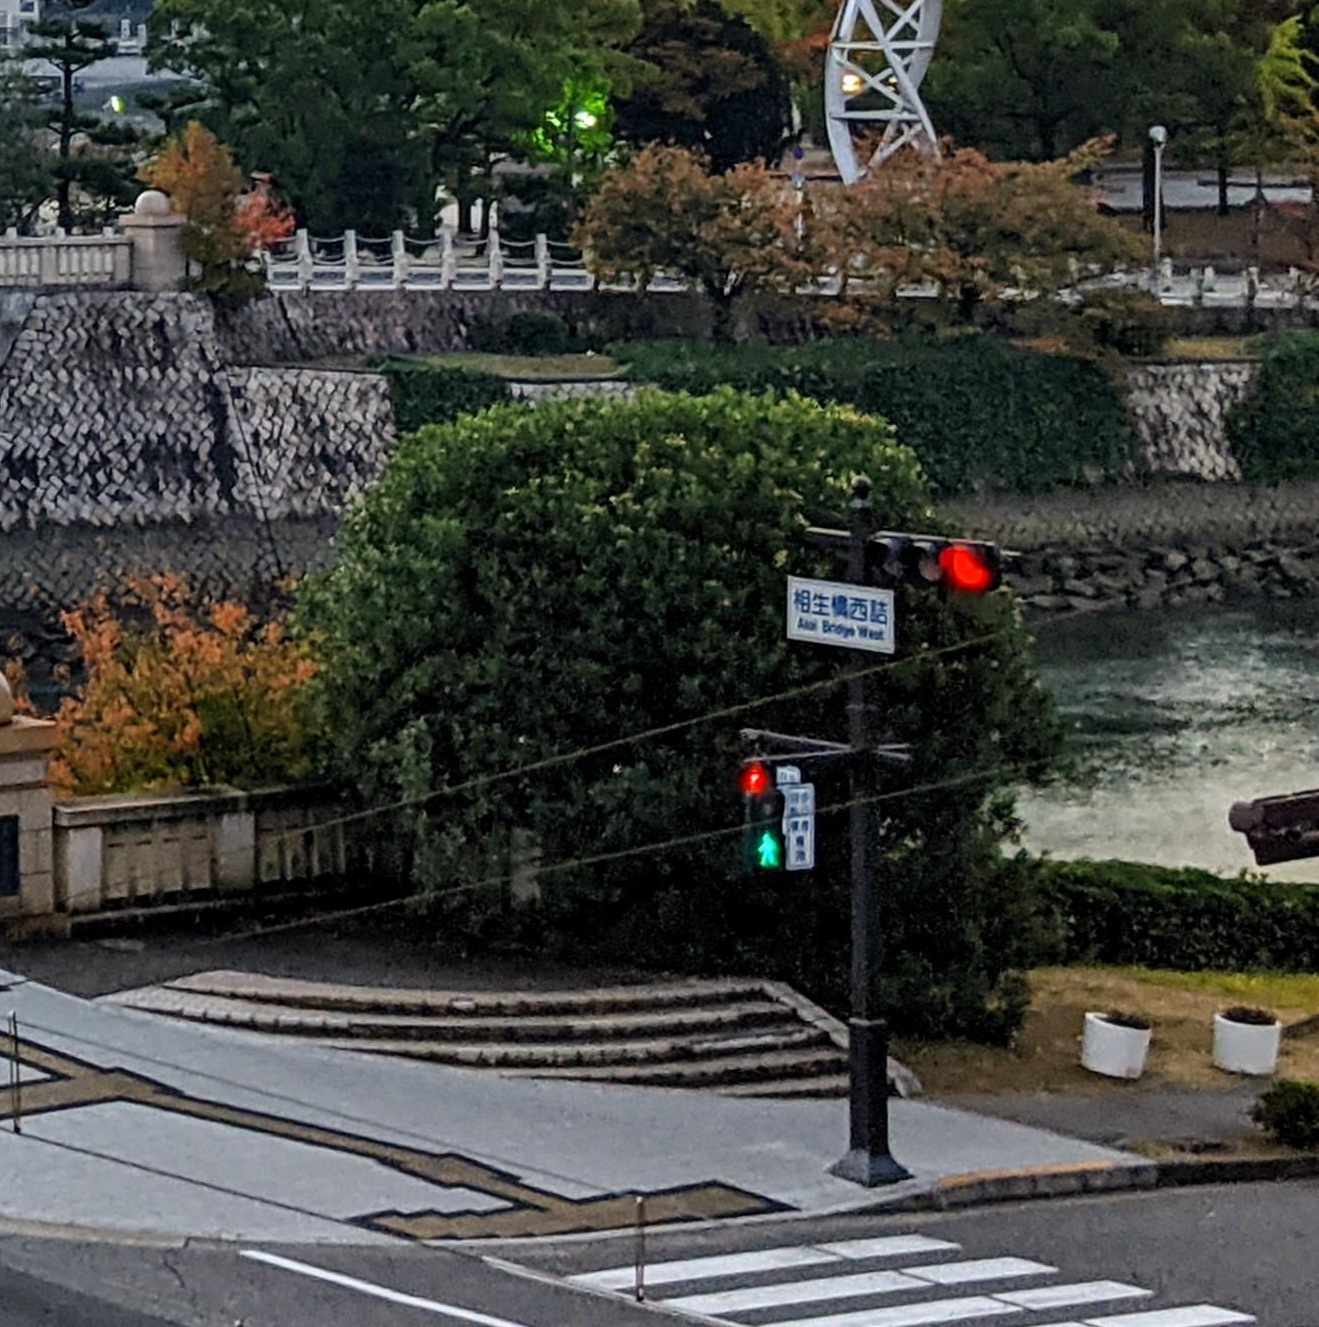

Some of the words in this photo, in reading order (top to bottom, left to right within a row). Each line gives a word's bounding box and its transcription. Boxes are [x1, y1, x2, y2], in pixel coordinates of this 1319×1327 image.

[793, 588, 888, 625] 相生橋西詰
[822, 620, 855, 638] Bridge
[857, 625, 884, 641] West
